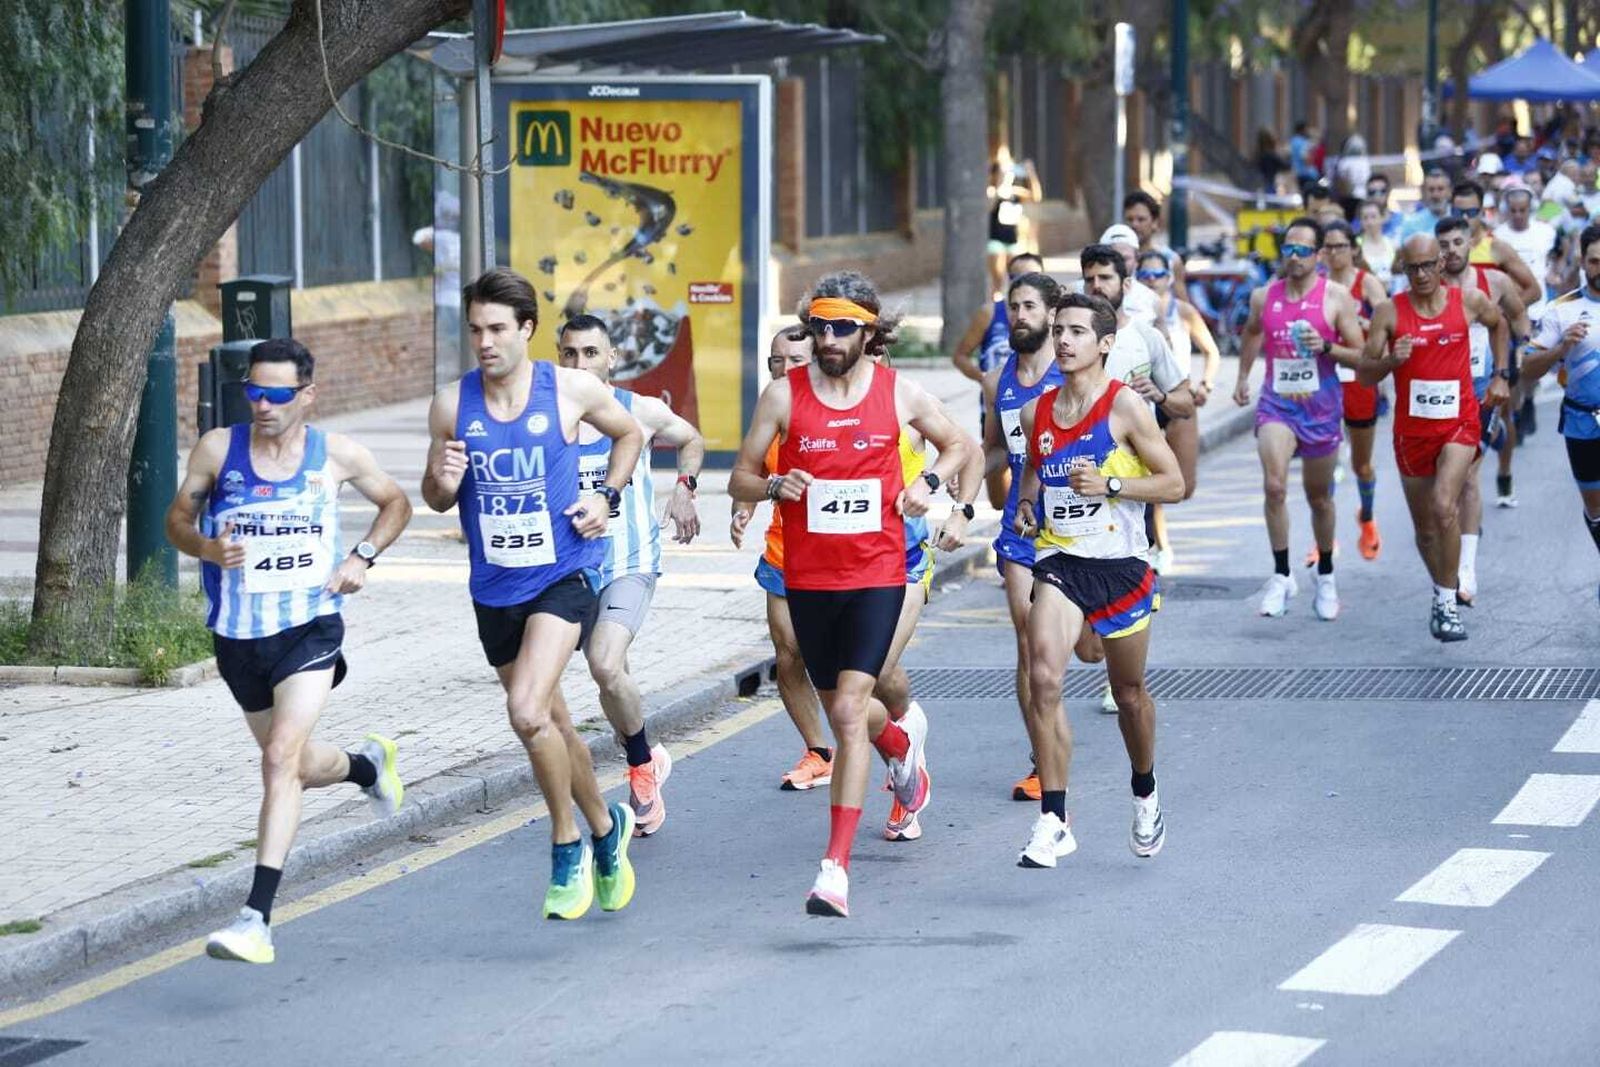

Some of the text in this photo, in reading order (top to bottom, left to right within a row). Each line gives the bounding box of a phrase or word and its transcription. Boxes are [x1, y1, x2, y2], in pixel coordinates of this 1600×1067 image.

[580, 117, 682, 142] Nuevo
[1280, 370, 1314, 382] 320
[1416, 394, 1456, 406] 662
[470, 446, 546, 481] RCM
[477, 491, 548, 516] 1873
[821, 500, 869, 514] 413
[1053, 503, 1102, 520] 257
[490, 532, 544, 549] 235
[254, 553, 313, 571] 485
